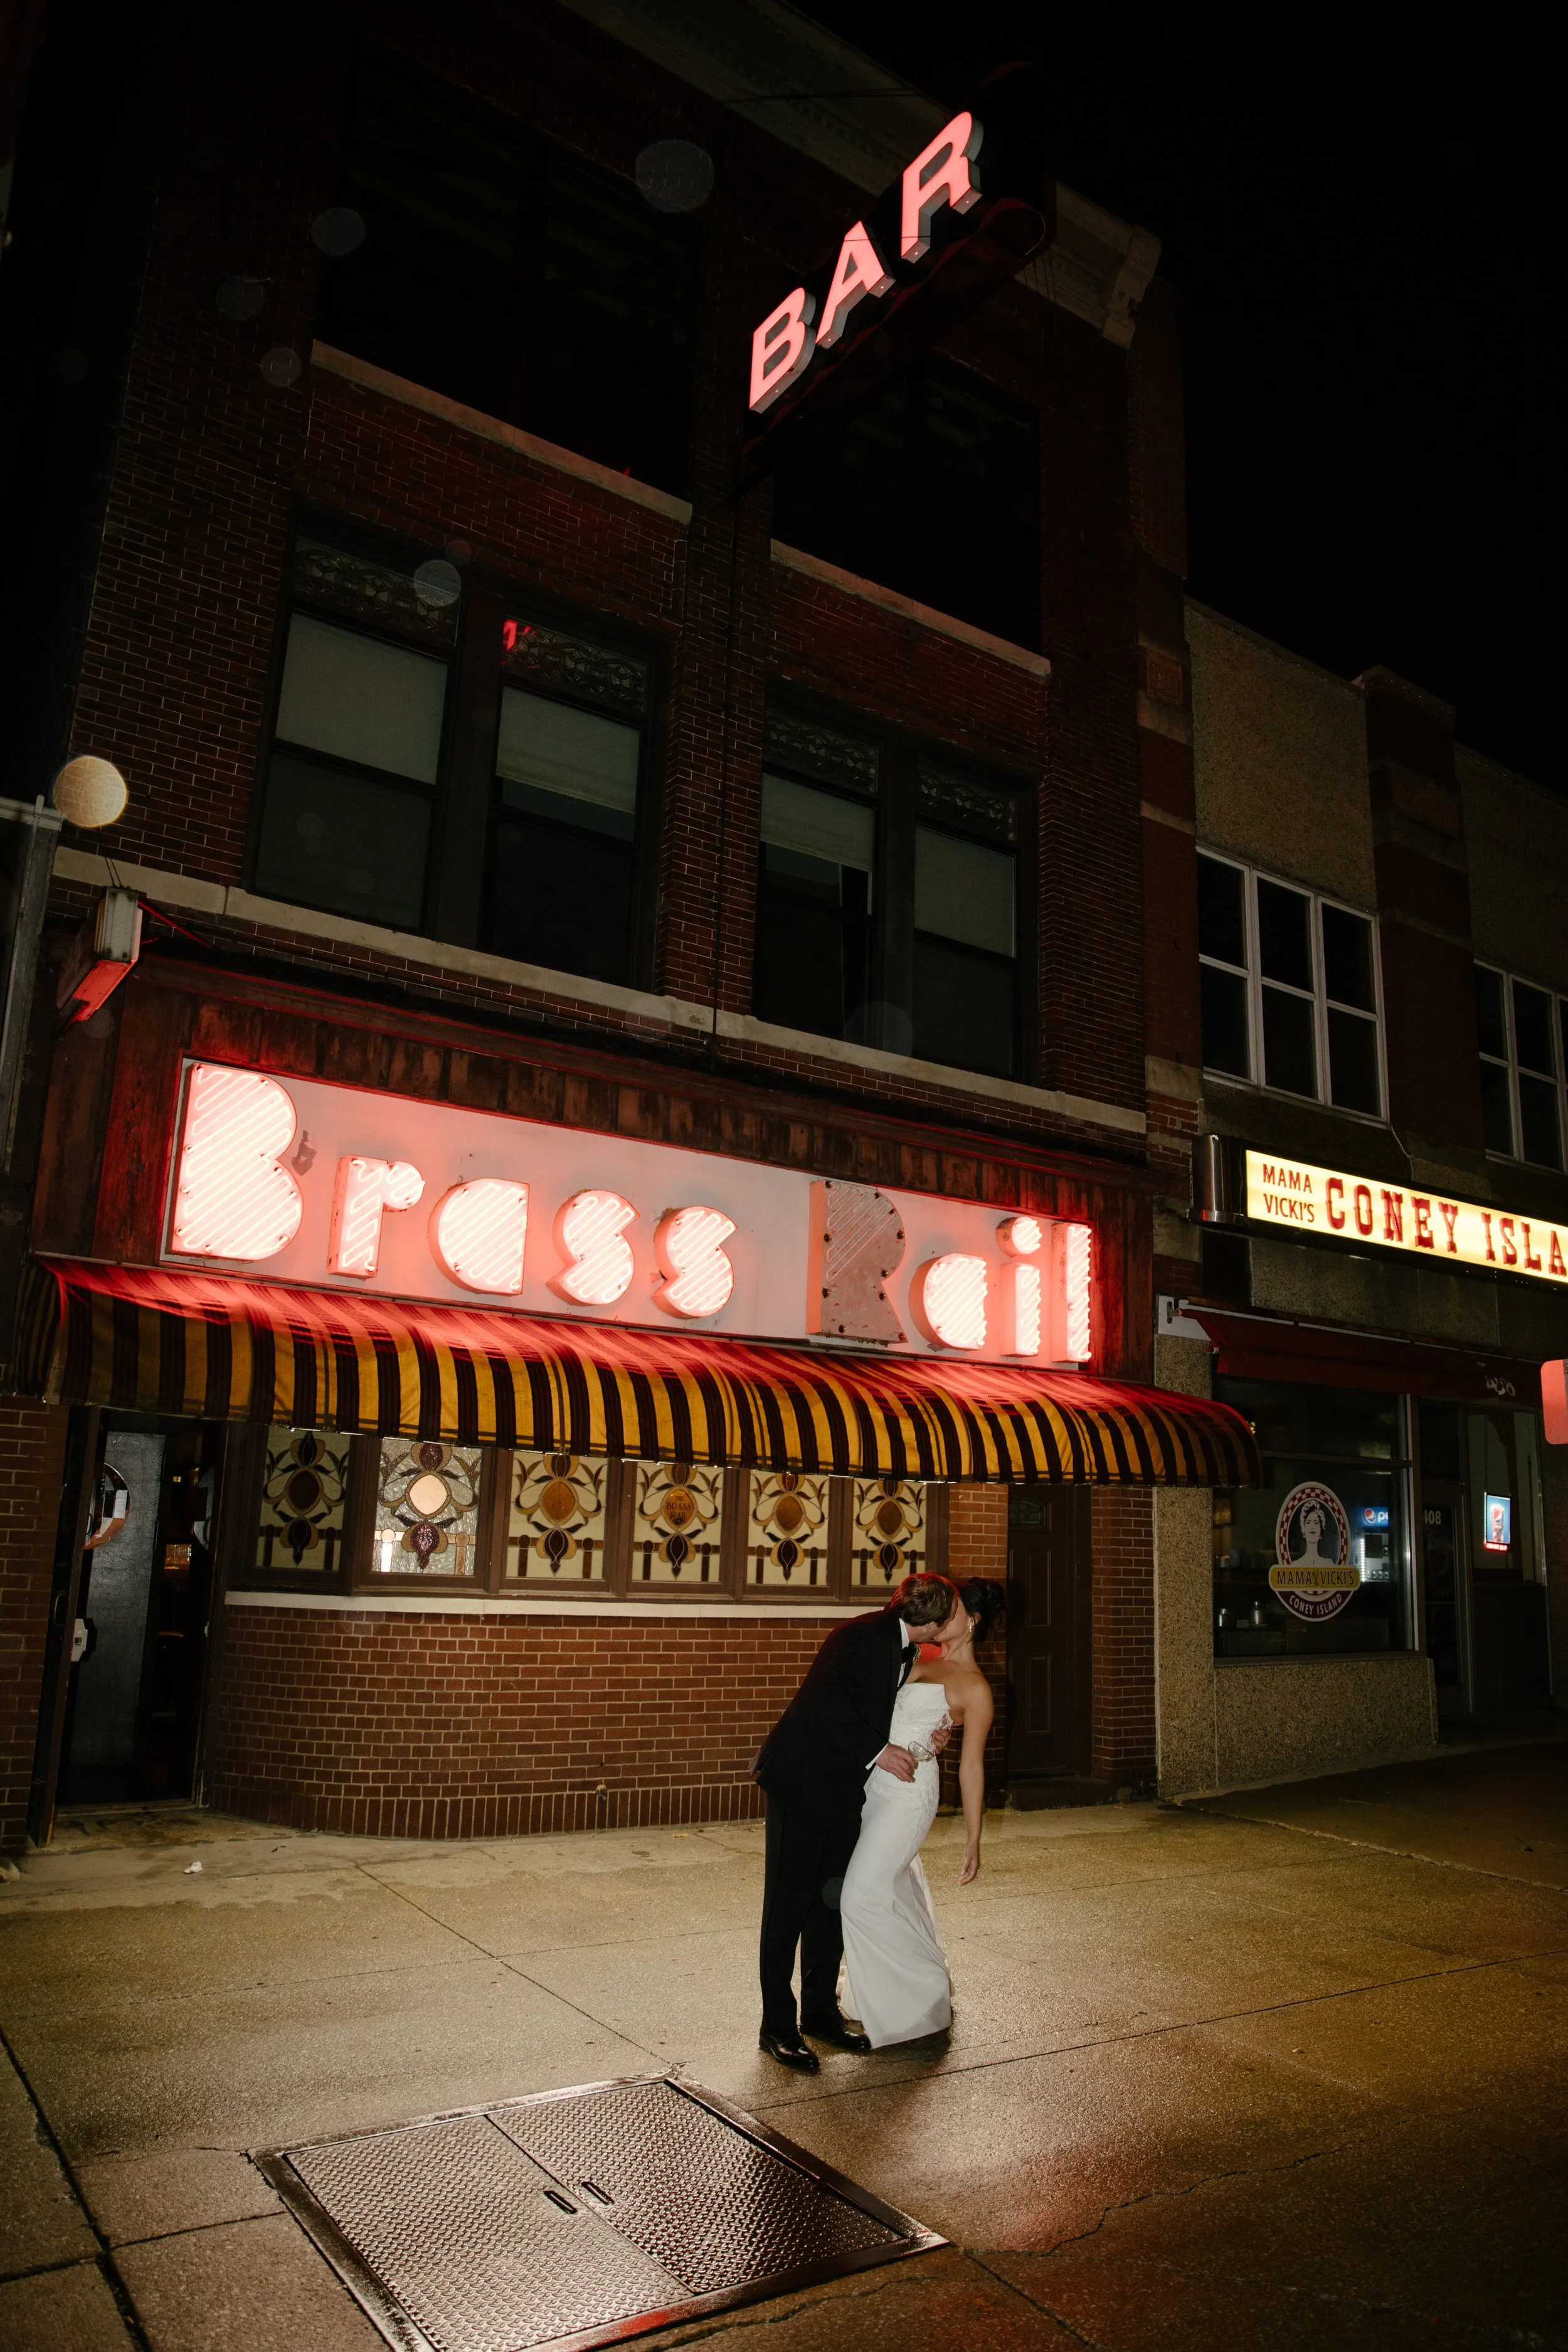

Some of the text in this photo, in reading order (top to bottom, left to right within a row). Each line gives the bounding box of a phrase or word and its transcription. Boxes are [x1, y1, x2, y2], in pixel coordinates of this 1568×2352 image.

[750, 112, 983, 414] BAR
[1263, 1163, 1313, 1194] MAMA
[169, 1062, 1093, 1364] Brass Rail
[1263, 1193, 1315, 1223] VICKI'S
[1325, 1177, 1459, 1253] CONEY
[667, 1502, 691, 1510] BRASS
[1277, 1571, 1354, 1585] MAMA VICKI'S
[1290, 1593, 1342, 1615] CONEY ISLAND
